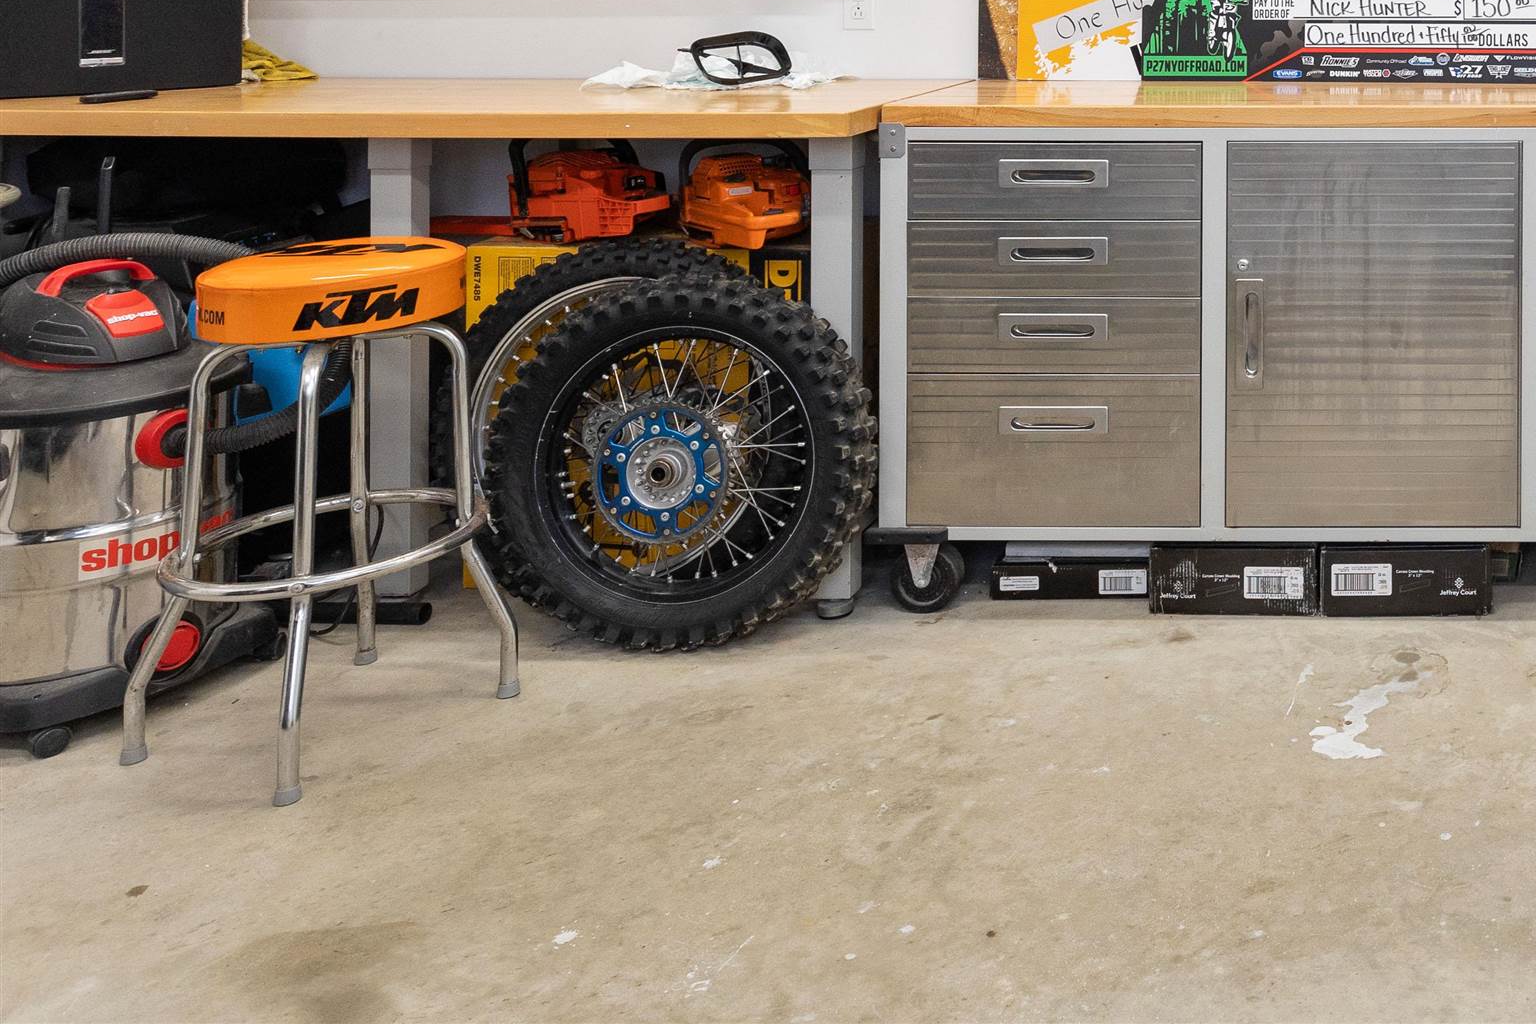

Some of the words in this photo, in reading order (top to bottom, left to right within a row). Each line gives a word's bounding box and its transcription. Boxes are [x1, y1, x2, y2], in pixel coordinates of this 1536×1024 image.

[1055, 11, 1102, 39] One
[1254, 9, 1279, 18] ORDER
[1280, 9, 1290, 18] OF
[1307, 25, 1345, 45] One
[1350, 24, 1416, 45] Hundred
[1479, 33, 1528, 46] DOLLARS
[473, 256, 482, 302] DWE7485
[292, 284, 420, 331] KTM
